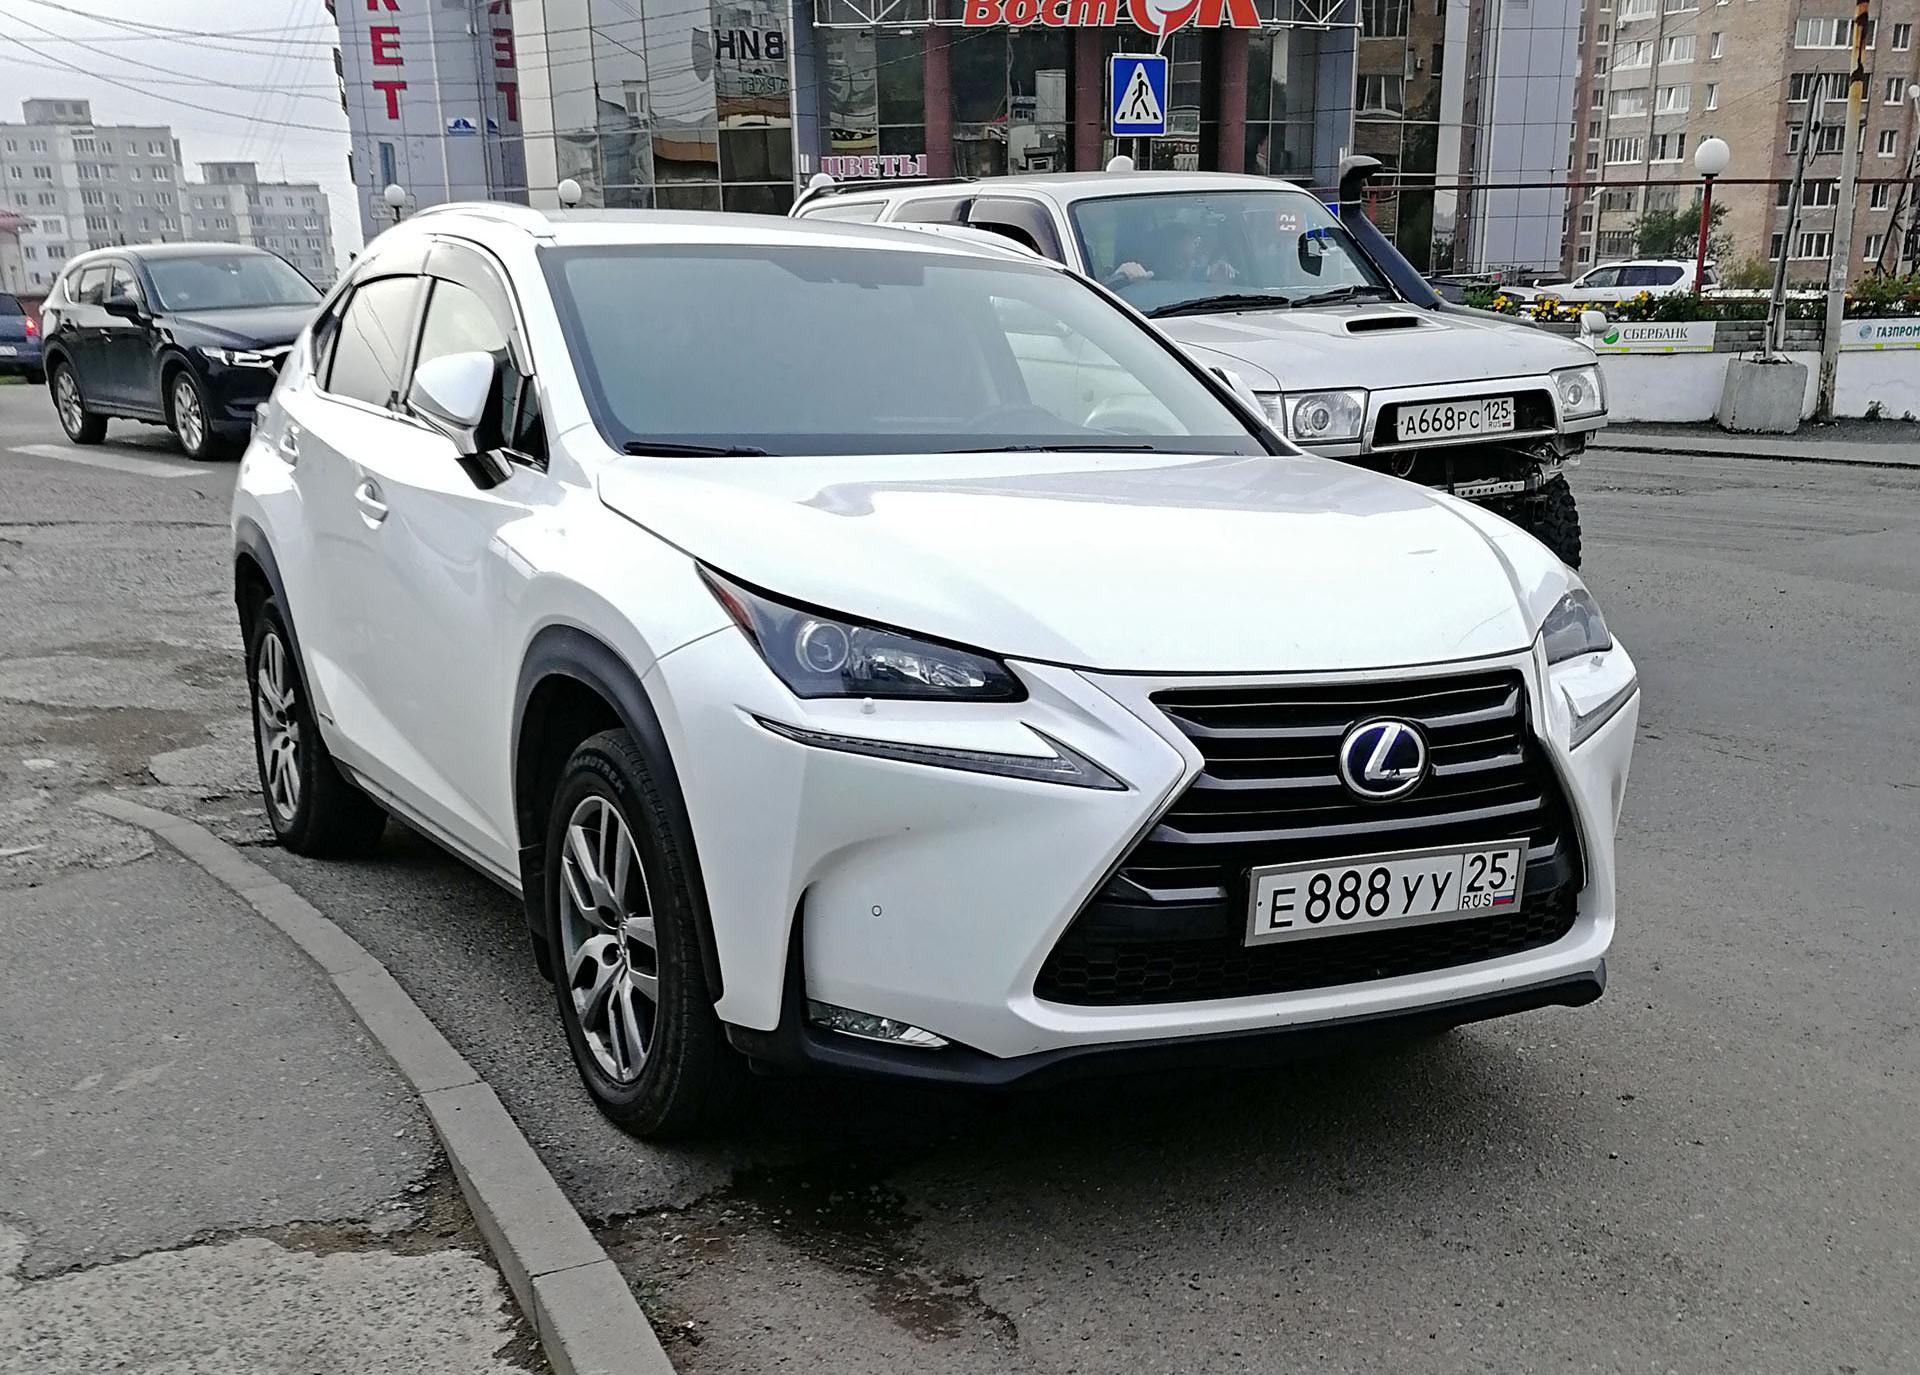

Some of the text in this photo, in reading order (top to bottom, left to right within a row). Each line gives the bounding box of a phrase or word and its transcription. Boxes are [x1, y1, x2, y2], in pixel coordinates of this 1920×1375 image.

[366, 0, 407, 120] ЕТ
[821, 154, 928, 181] ЦВЕТЫ
[1623, 327, 1689, 341] СБЕРБАНК
[1405, 400, 1509, 436] А668РС 125
[1269, 851, 1509, 929] Е888УУ 25
[1462, 893, 1492, 909] RUS
